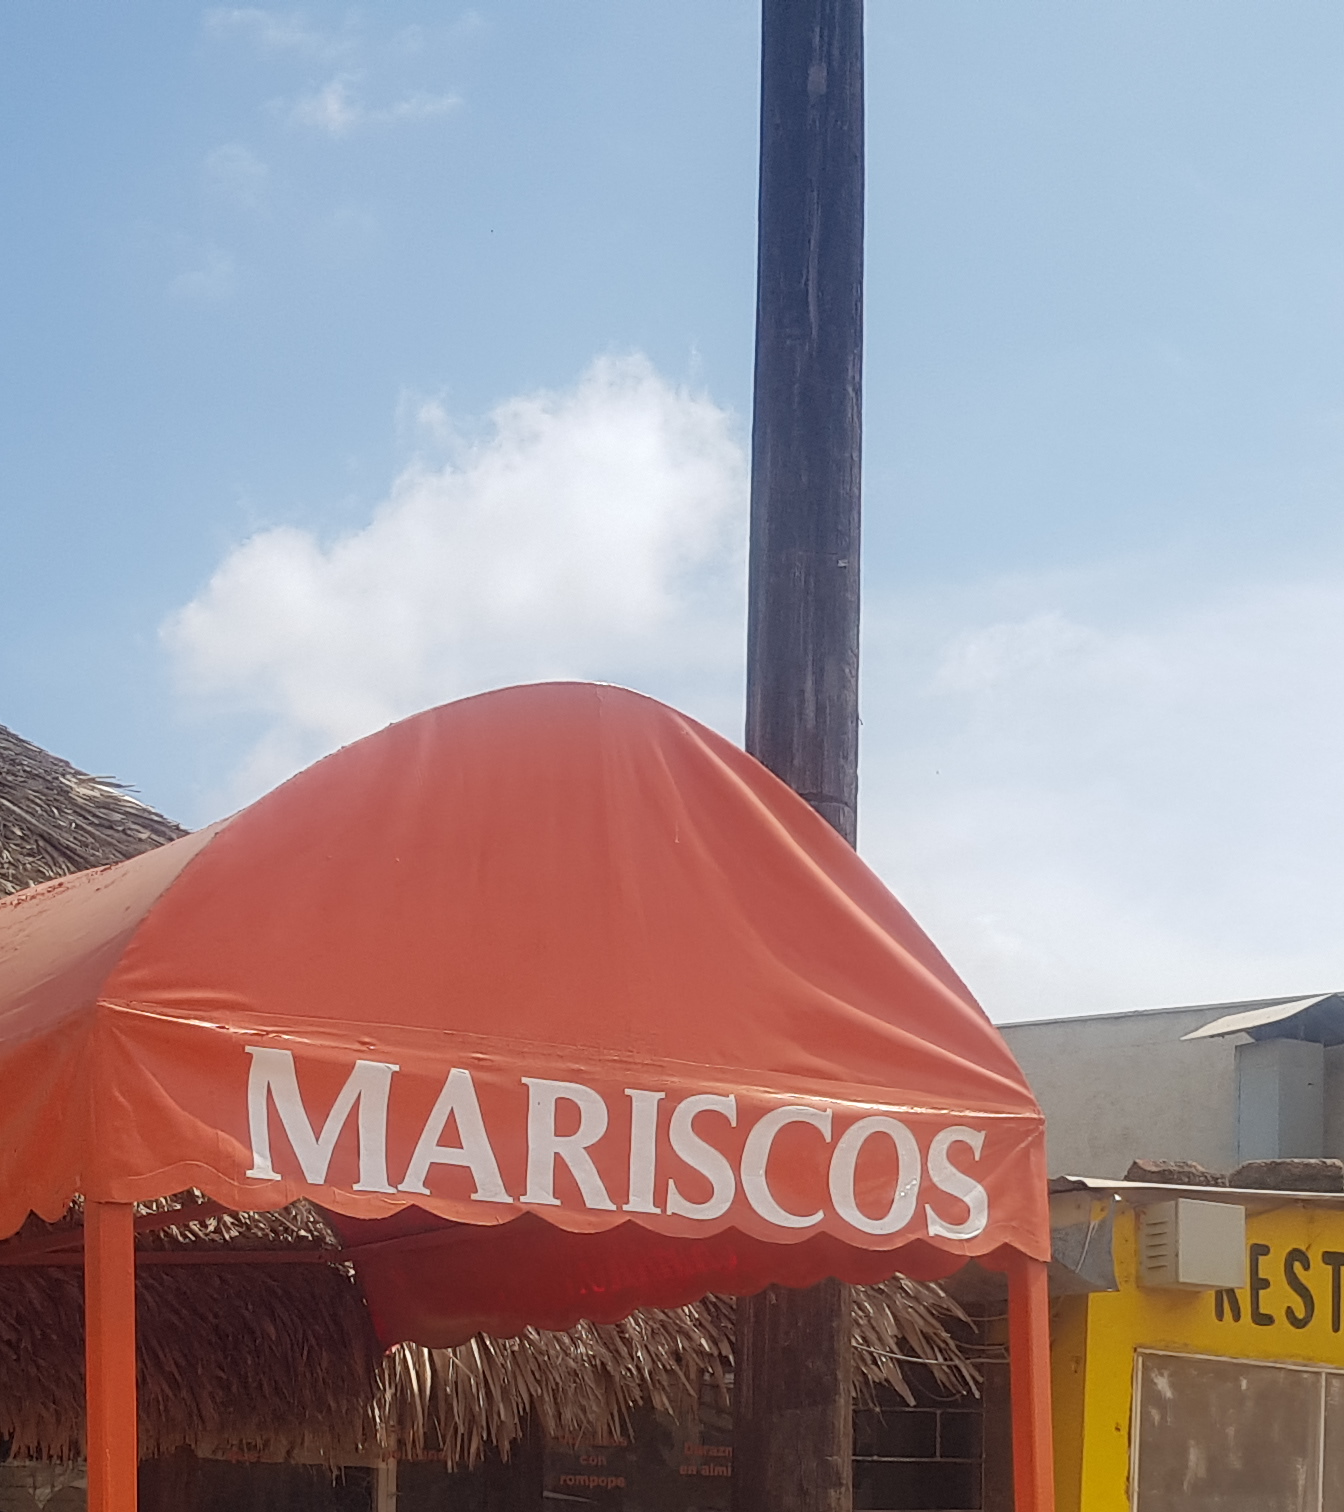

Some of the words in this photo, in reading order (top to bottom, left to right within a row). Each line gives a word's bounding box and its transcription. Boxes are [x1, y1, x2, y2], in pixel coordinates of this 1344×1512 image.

[244, 1046, 989, 1240] MARISCOS
[701, 1462, 732, 1477] almi
[559, 1474, 626, 1490] rompope
